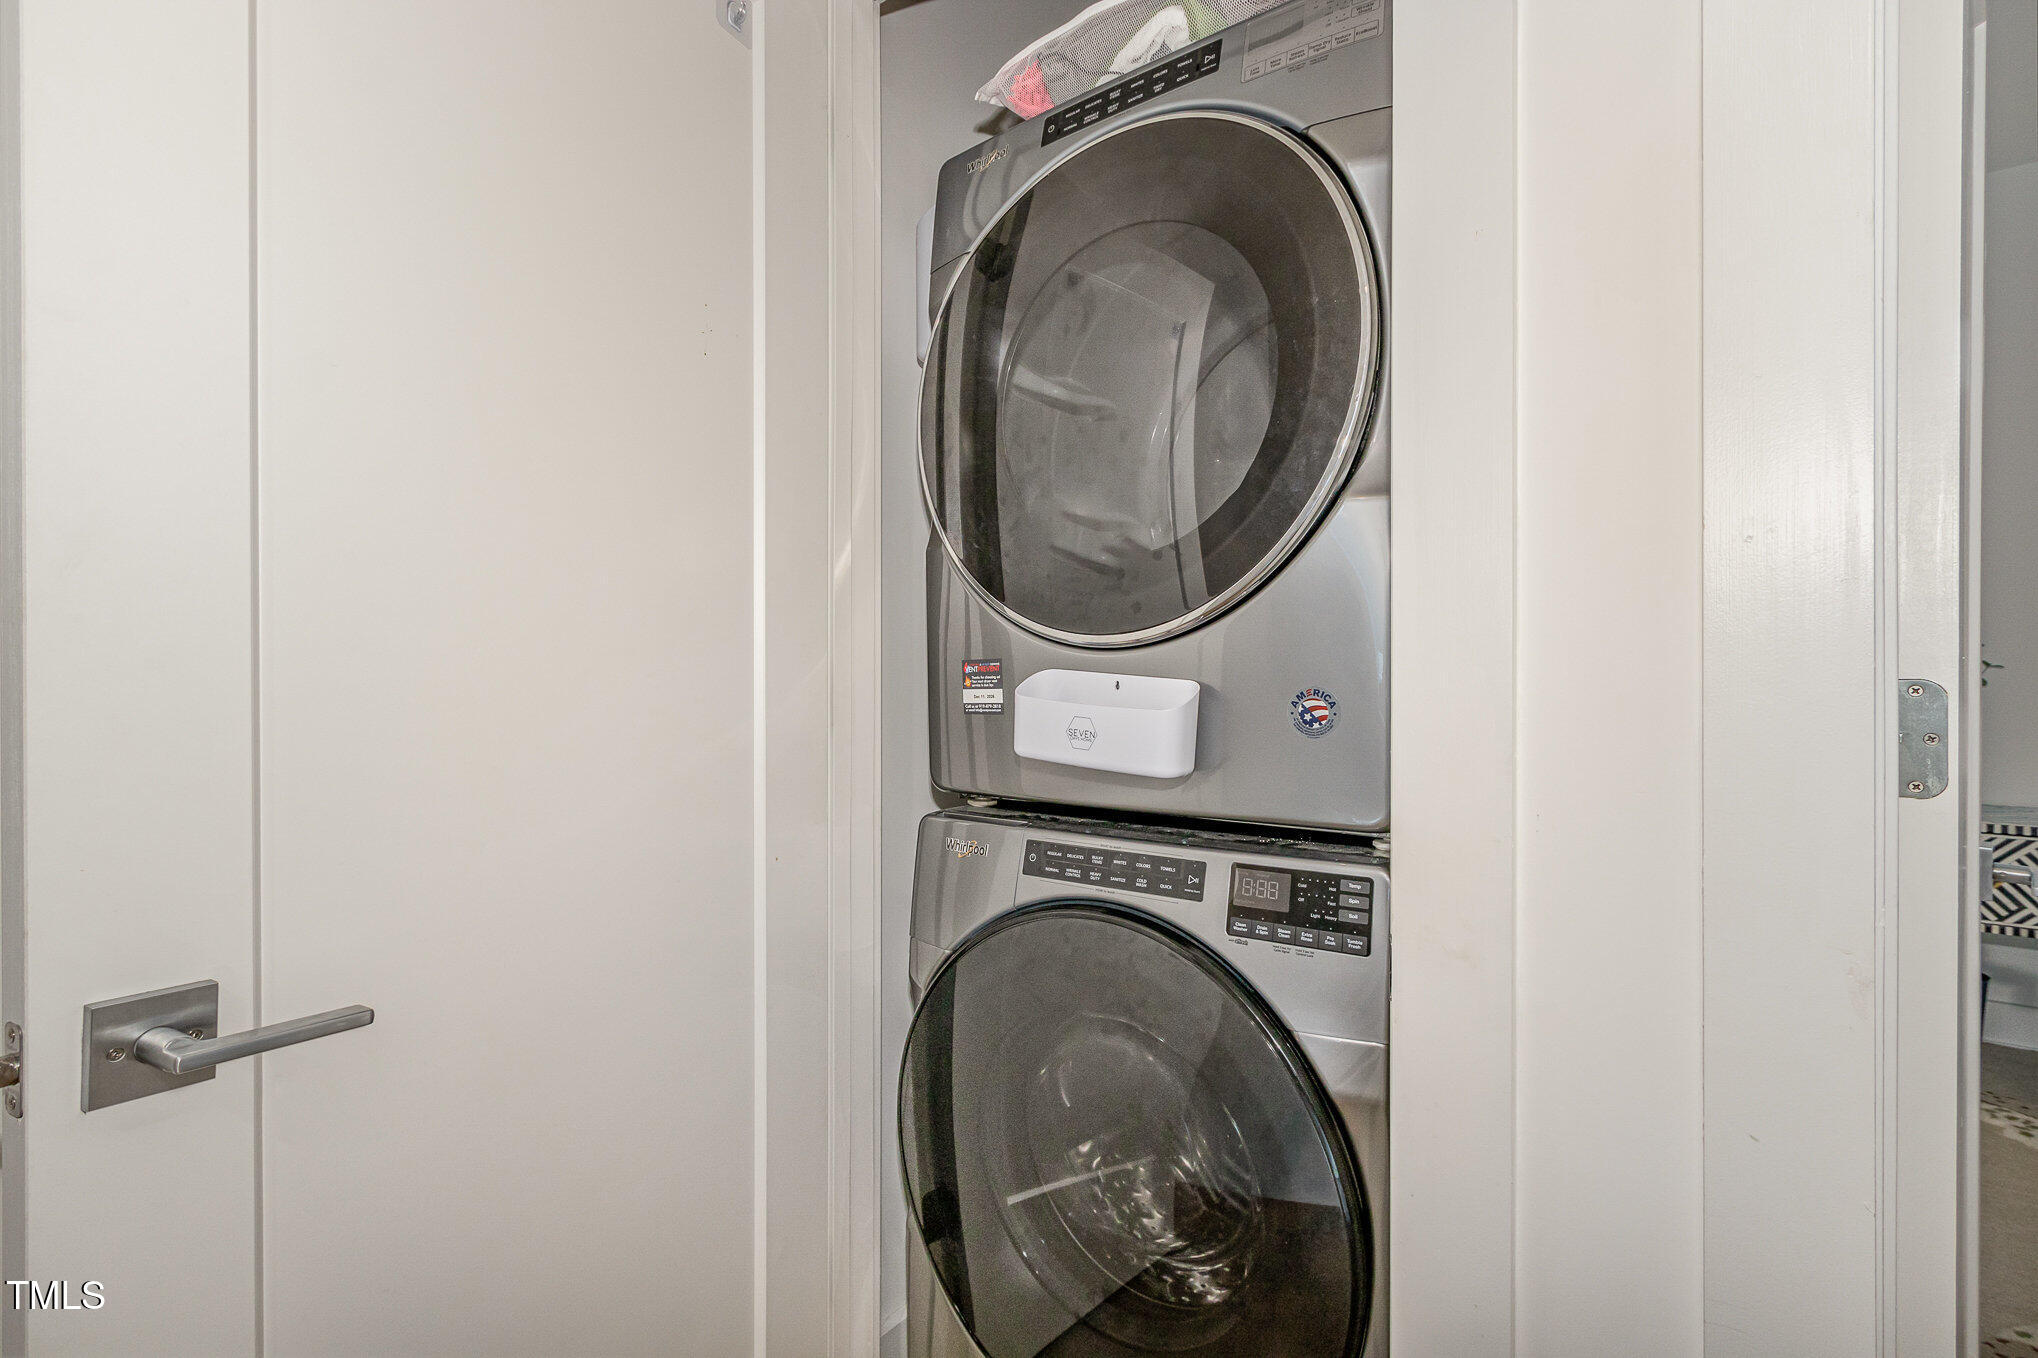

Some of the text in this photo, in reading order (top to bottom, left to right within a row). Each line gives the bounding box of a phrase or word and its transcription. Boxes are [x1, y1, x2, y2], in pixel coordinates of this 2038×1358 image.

[1176, 74, 1189, 82] QUICK
[966, 144, 1010, 175] Whirlpool
[1291, 688, 1337, 709] AMERICA
[1068, 728, 1096, 739] SEVEN
[946, 837, 990, 858] Whirlpool
[1160, 865, 1176, 873] TOWELS
[1348, 882, 1362, 890] Temp
[1346, 938, 1363, 946] Tumble
